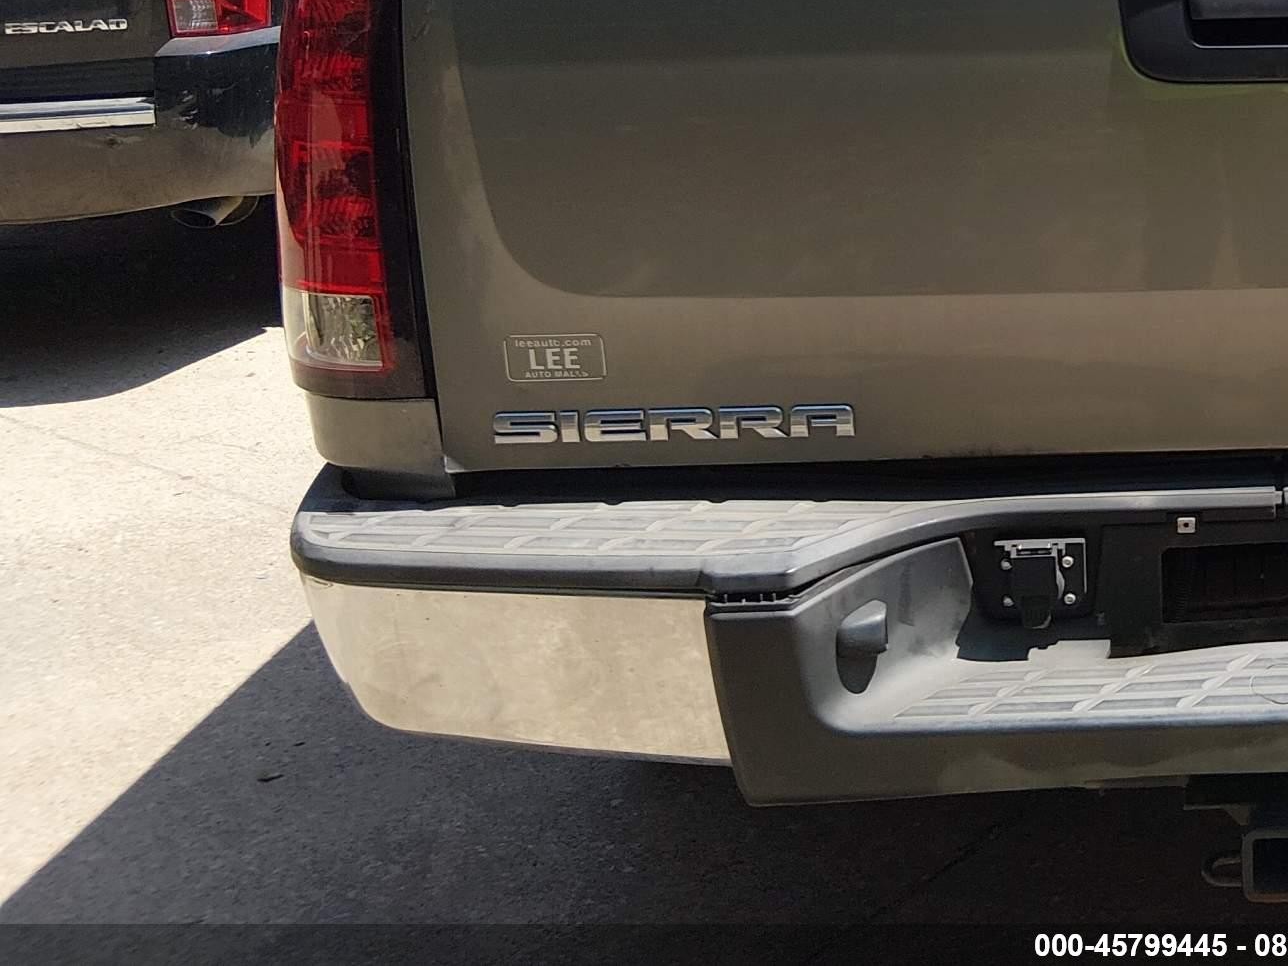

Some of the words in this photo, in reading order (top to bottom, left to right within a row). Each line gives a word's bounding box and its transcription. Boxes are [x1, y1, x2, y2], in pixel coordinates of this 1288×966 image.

[4, 18, 128, 35] ESCALAD
[528, 347, 581, 370] LEE
[525, 370, 552, 378] AUTO
[493, 403, 856, 445] SIERRA
